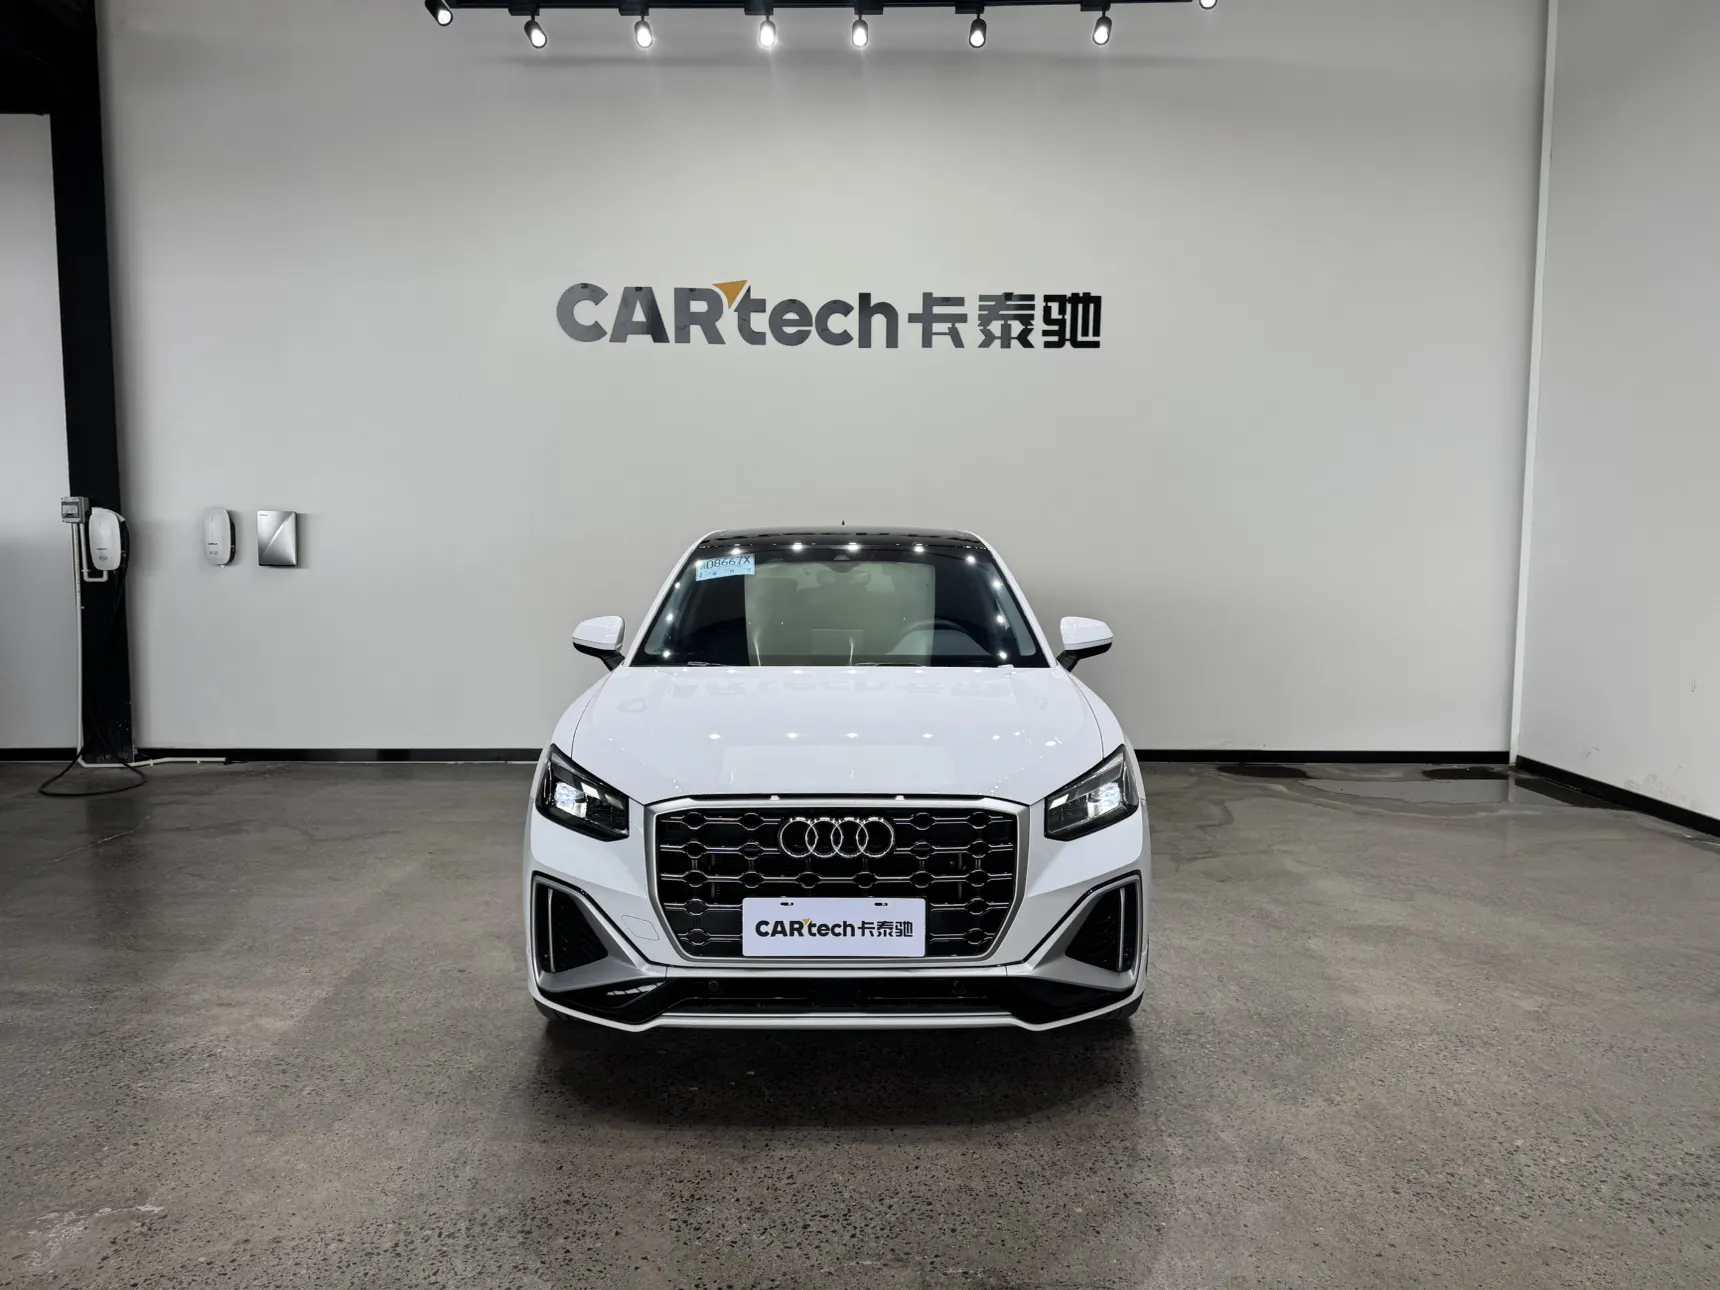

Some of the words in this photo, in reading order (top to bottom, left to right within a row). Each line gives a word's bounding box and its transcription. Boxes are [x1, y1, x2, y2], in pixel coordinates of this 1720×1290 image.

[556, 282, 898, 348] CARtech
[907, 291, 1102, 349] 卡泰驰
[755, 920, 855, 938] CARtech
[857, 920, 913, 938] 卡泰驰
